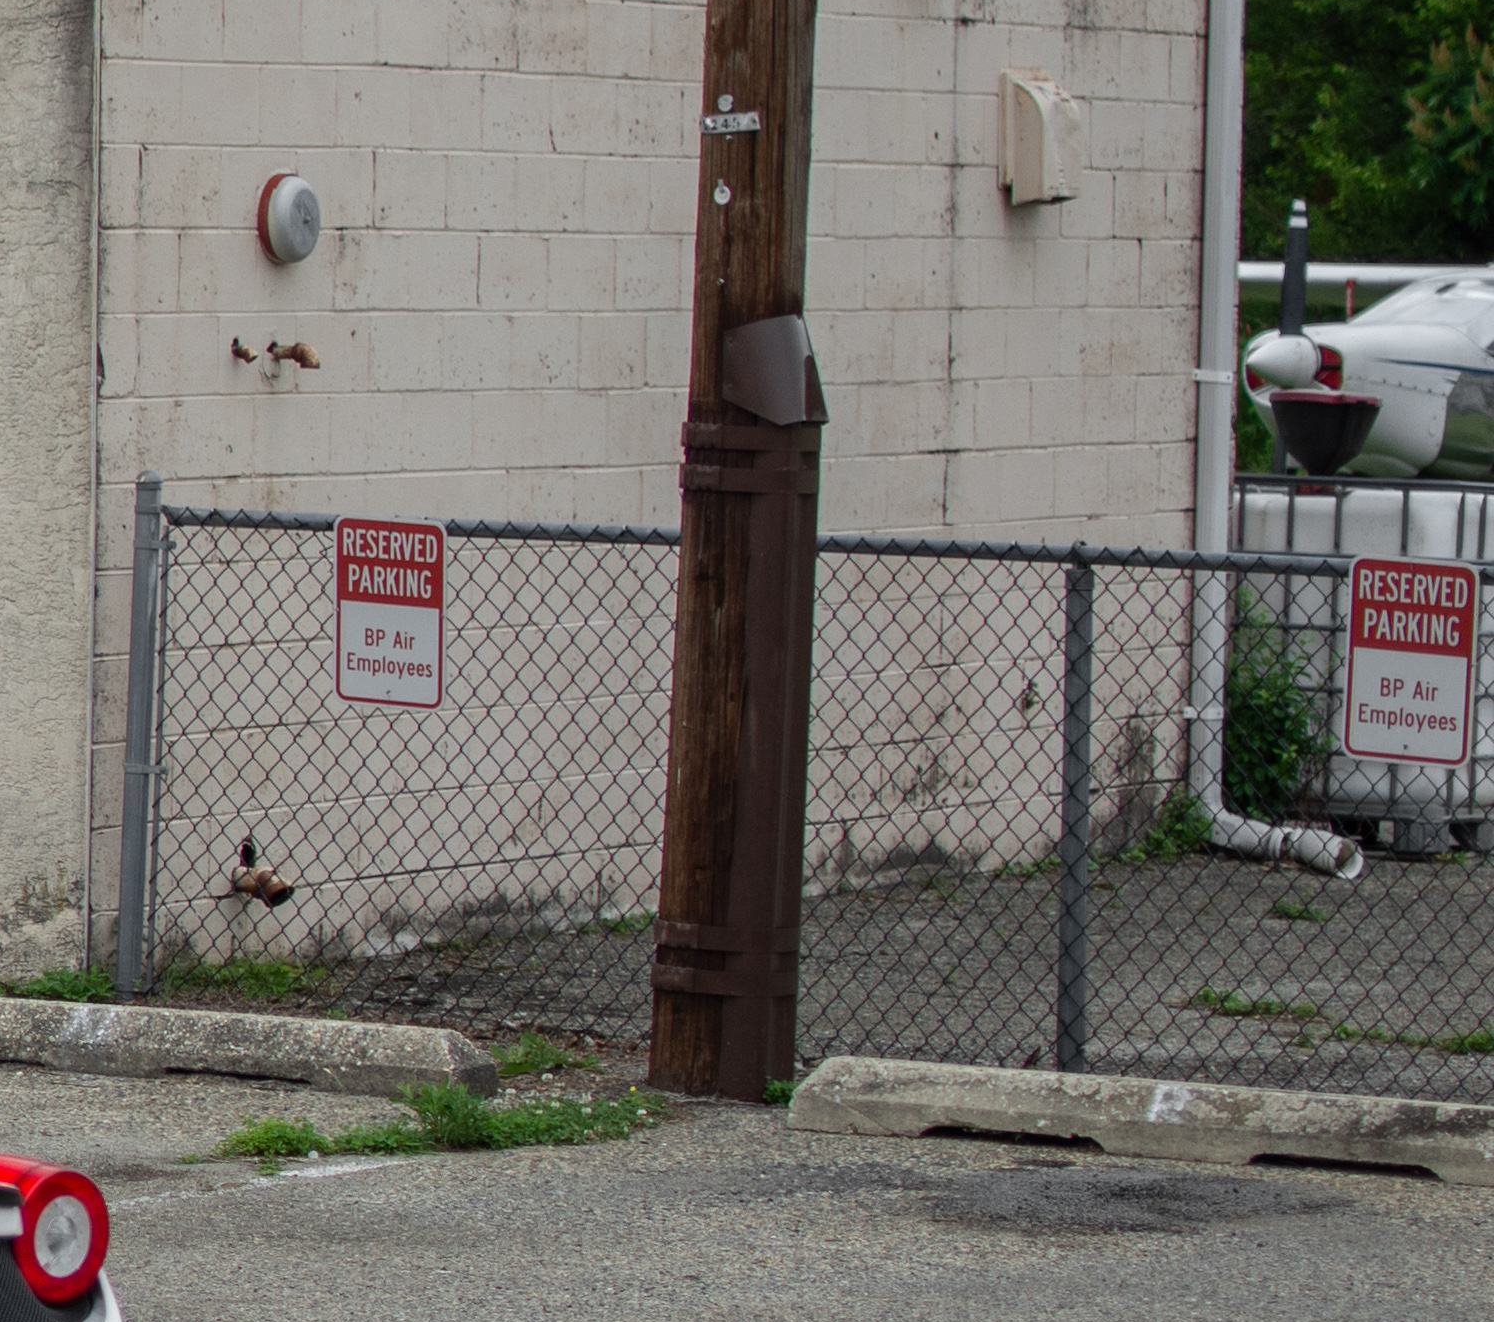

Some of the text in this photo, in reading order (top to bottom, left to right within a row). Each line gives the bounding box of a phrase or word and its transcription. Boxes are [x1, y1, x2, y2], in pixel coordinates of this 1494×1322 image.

[342, 527, 438, 564] RESERVED
[347, 564, 432, 599] PARKING
[1359, 568, 1468, 609] RESERVED
[365, 628, 415, 650] BP Air
[1363, 608, 1460, 647] PARKING
[346, 652, 432, 679] Employees
[1380, 677, 1438, 702] BP Air
[1358, 703, 1457, 733] Employees
